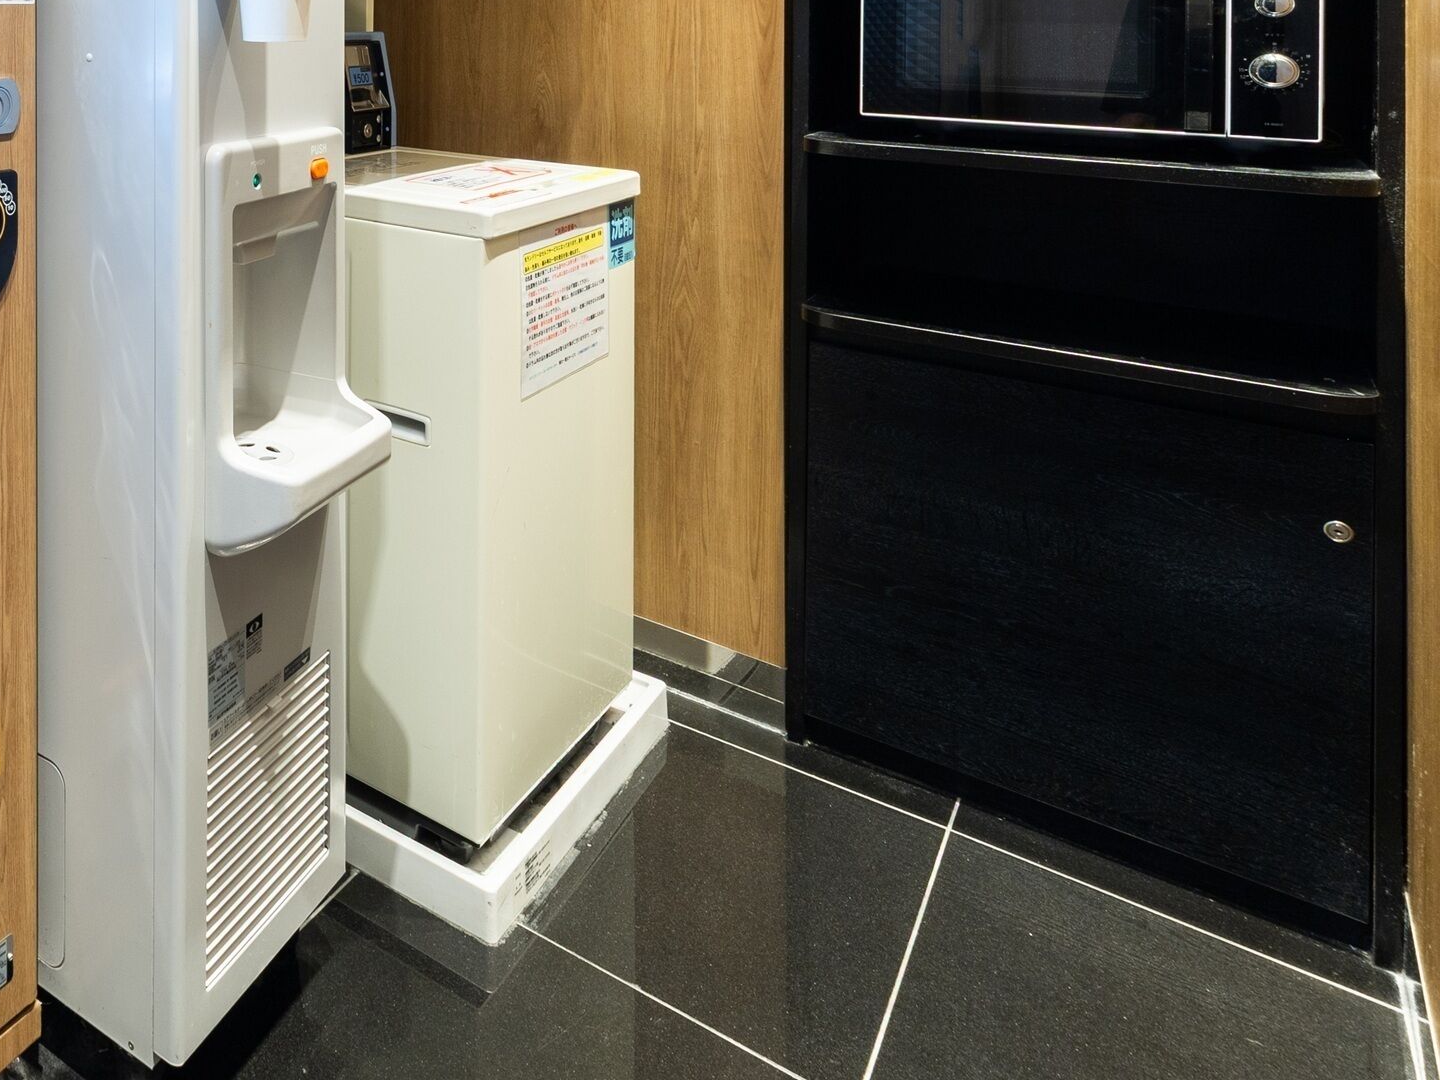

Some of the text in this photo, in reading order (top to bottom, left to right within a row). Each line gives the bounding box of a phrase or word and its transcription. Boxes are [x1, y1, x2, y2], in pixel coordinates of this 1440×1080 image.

[353, 71, 370, 86] ¥500
[311, 143, 327, 155] PUSH
[611, 205, 633, 242] 洗剤
[611, 246, 624, 266] 不要
